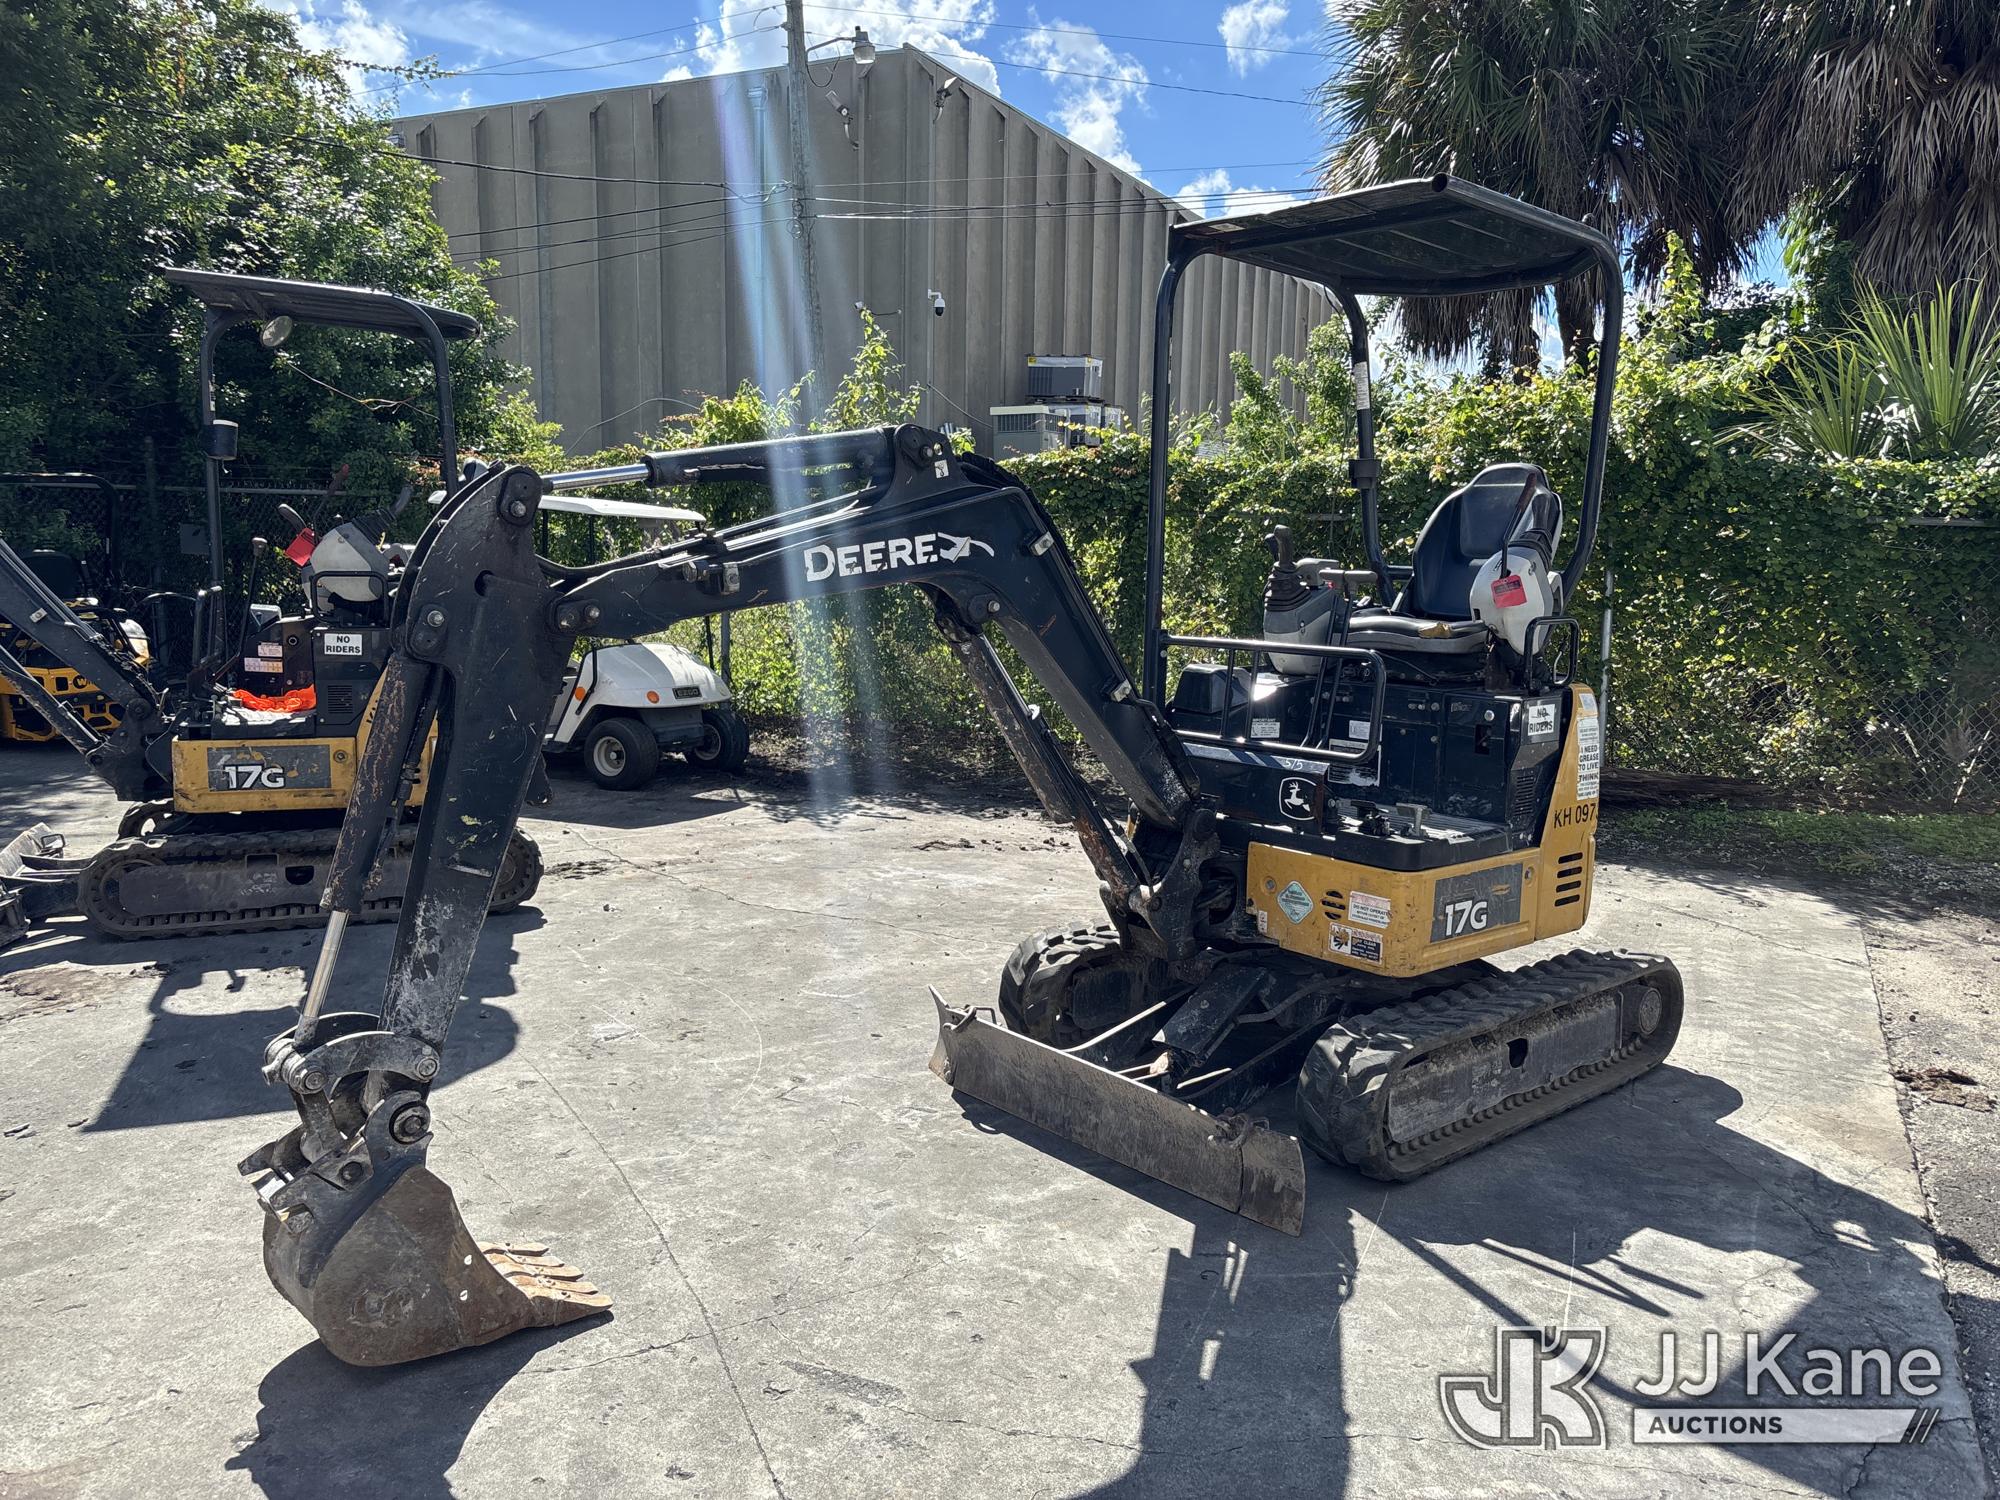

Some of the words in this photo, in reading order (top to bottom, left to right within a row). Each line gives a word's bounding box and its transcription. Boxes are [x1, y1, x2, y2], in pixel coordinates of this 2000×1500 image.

[803, 532, 939, 583] DEERE
[336, 635, 351, 644] NO
[325, 645, 361, 654] RIDERS
[1528, 720, 1554, 734] RIDERS
[1585, 745, 1598, 753] NEED
[1579, 753, 1599, 763] GREASE
[1587, 762, 1599, 770] LIVE
[225, 765, 285, 789] 17G
[1553, 807, 1572, 828] KH
[1575, 802, 1599, 824] 097
[1445, 900, 1488, 936] 17G
